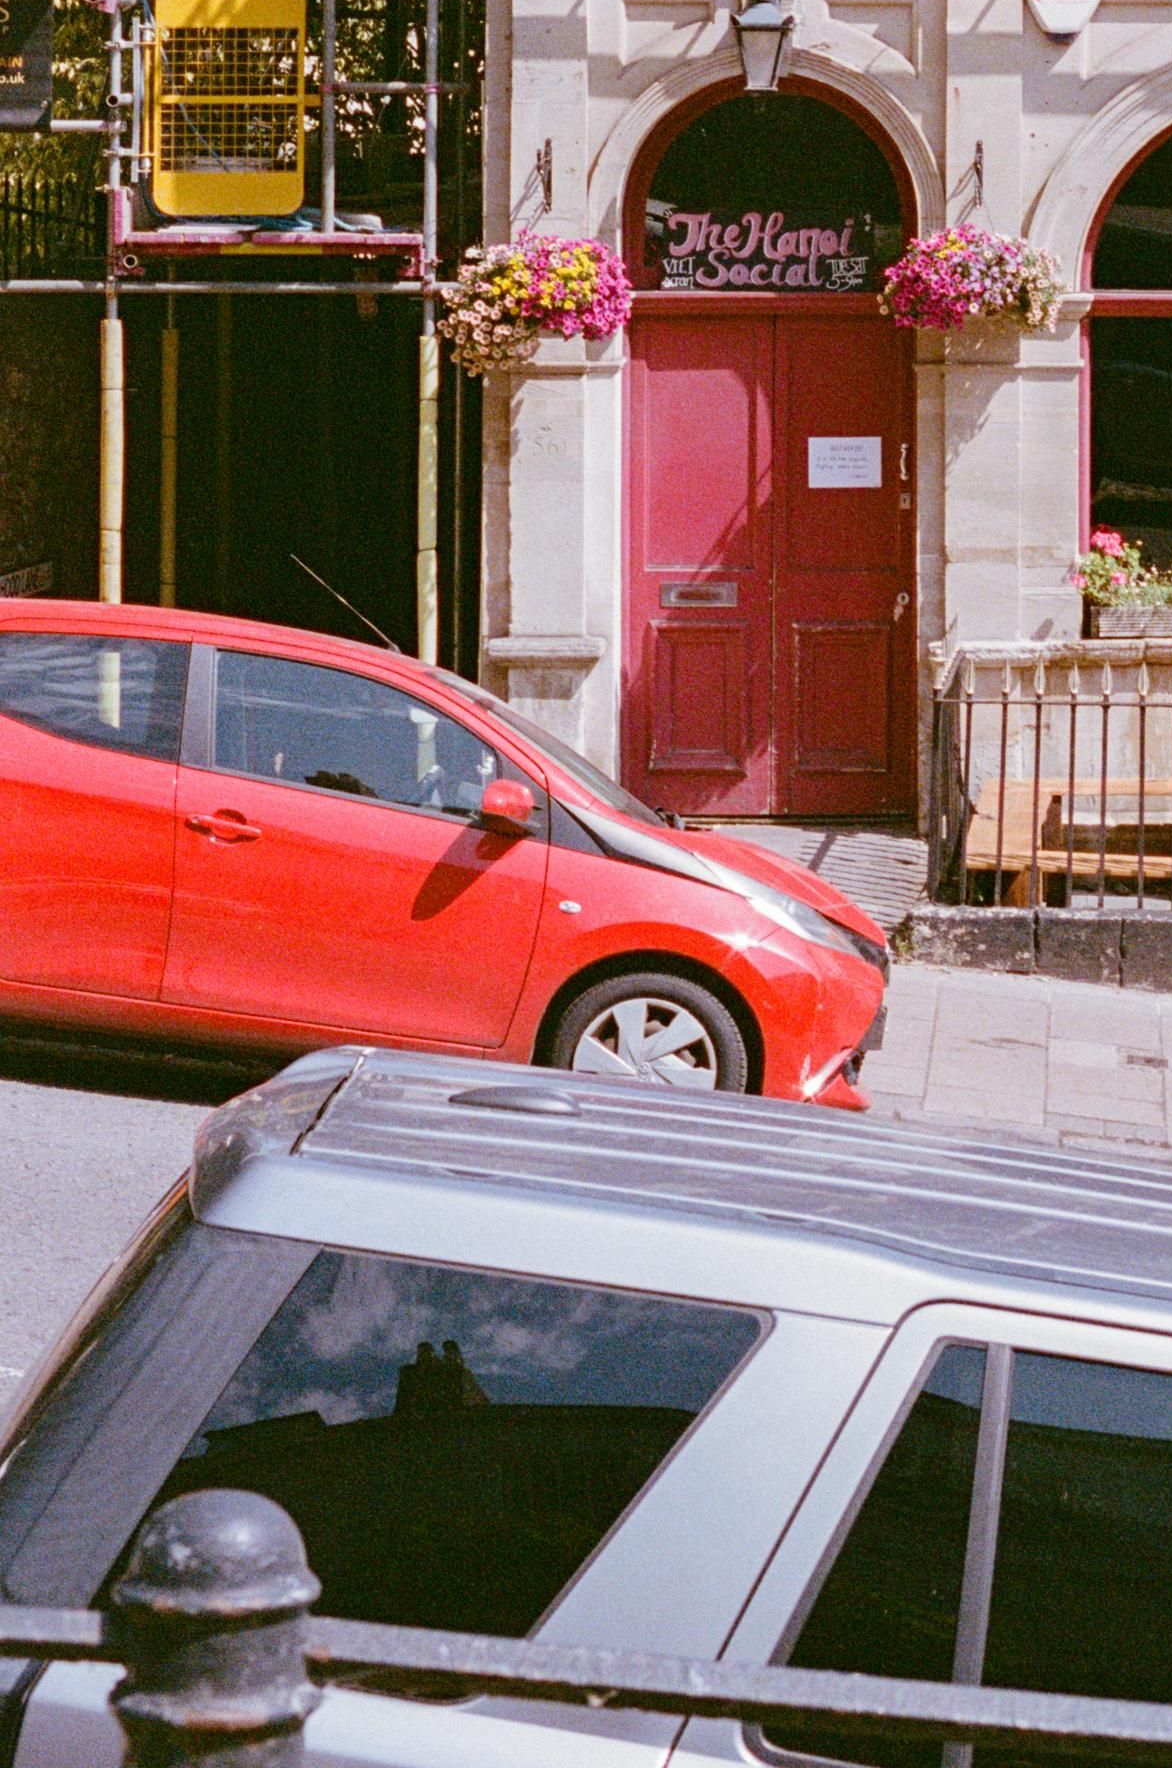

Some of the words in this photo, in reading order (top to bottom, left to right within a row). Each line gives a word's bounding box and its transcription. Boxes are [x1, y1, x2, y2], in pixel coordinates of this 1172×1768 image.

[668, 212, 743, 257] The
[732, 212, 854, 263] Hanoi
[662, 256, 696, 274] VIET
[695, 248, 823, 288] Social
